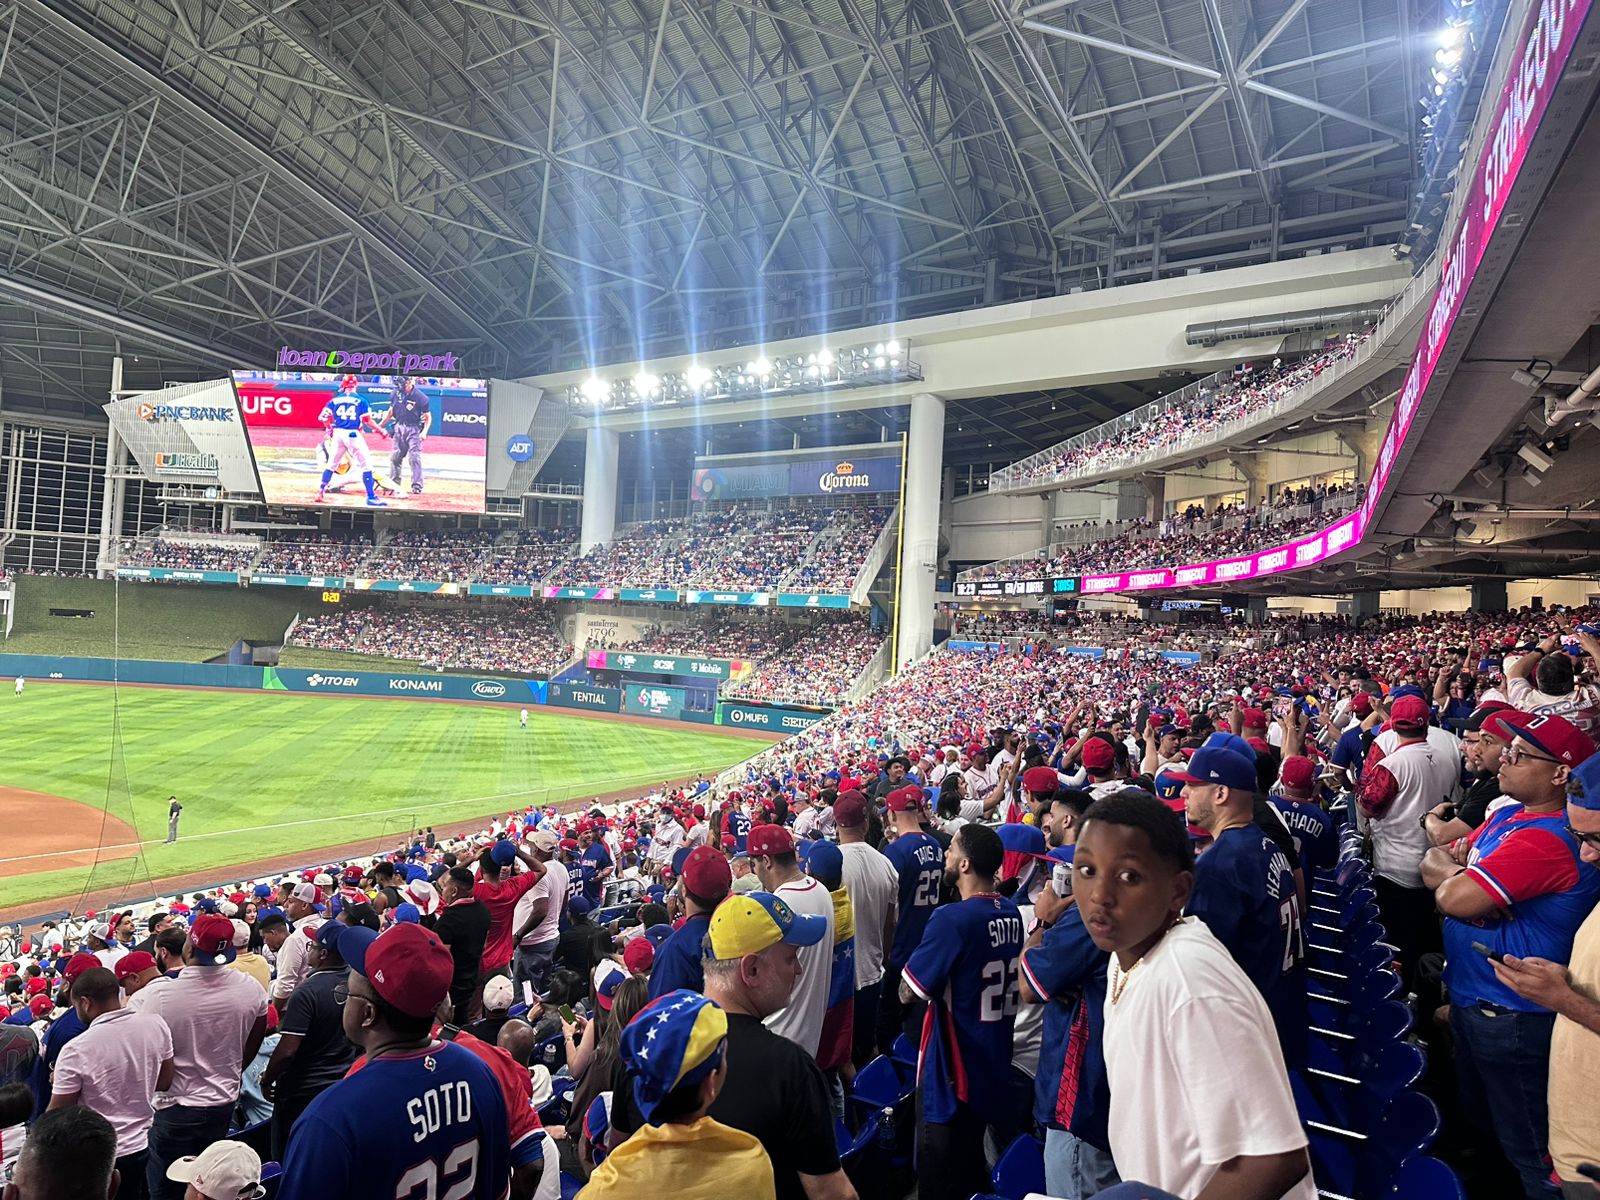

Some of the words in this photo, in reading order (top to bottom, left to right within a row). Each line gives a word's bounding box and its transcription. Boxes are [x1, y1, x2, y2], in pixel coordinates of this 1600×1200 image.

[1484, 0, 1576, 222] STRIKEOU
[278, 346, 400, 373] loanDepot
[403, 352, 459, 373] park
[239, 395, 292, 415] UFG
[335, 404, 357, 421] 44
[509, 442, 531, 454] ADT
[730, 471, 785, 492] MIAMI
[819, 471, 869, 492] Corona
[1085, 577, 1121, 589] STRIKEOUT
[1128, 572, 1165, 587] STRIKEOUT
[322, 592, 340, 602] 0:20
[590, 627, 616, 639] 1796
[698, 663, 722, 674] Mobile
[322, 676, 342, 685] ITO
[342, 677, 359, 686] EN
[389, 678, 442, 692] KONAMI
[474, 680, 504, 695] Kowa
[571, 690, 606, 705] TENTIAL
[744, 713, 769, 723] MUFG
[736, 820, 752, 836] 23
[913, 869, 943, 907] 23
[987, 917, 1020, 948] SOTO
[980, 957, 1020, 1022] 22
[406, 1080, 472, 1143] SOTO
